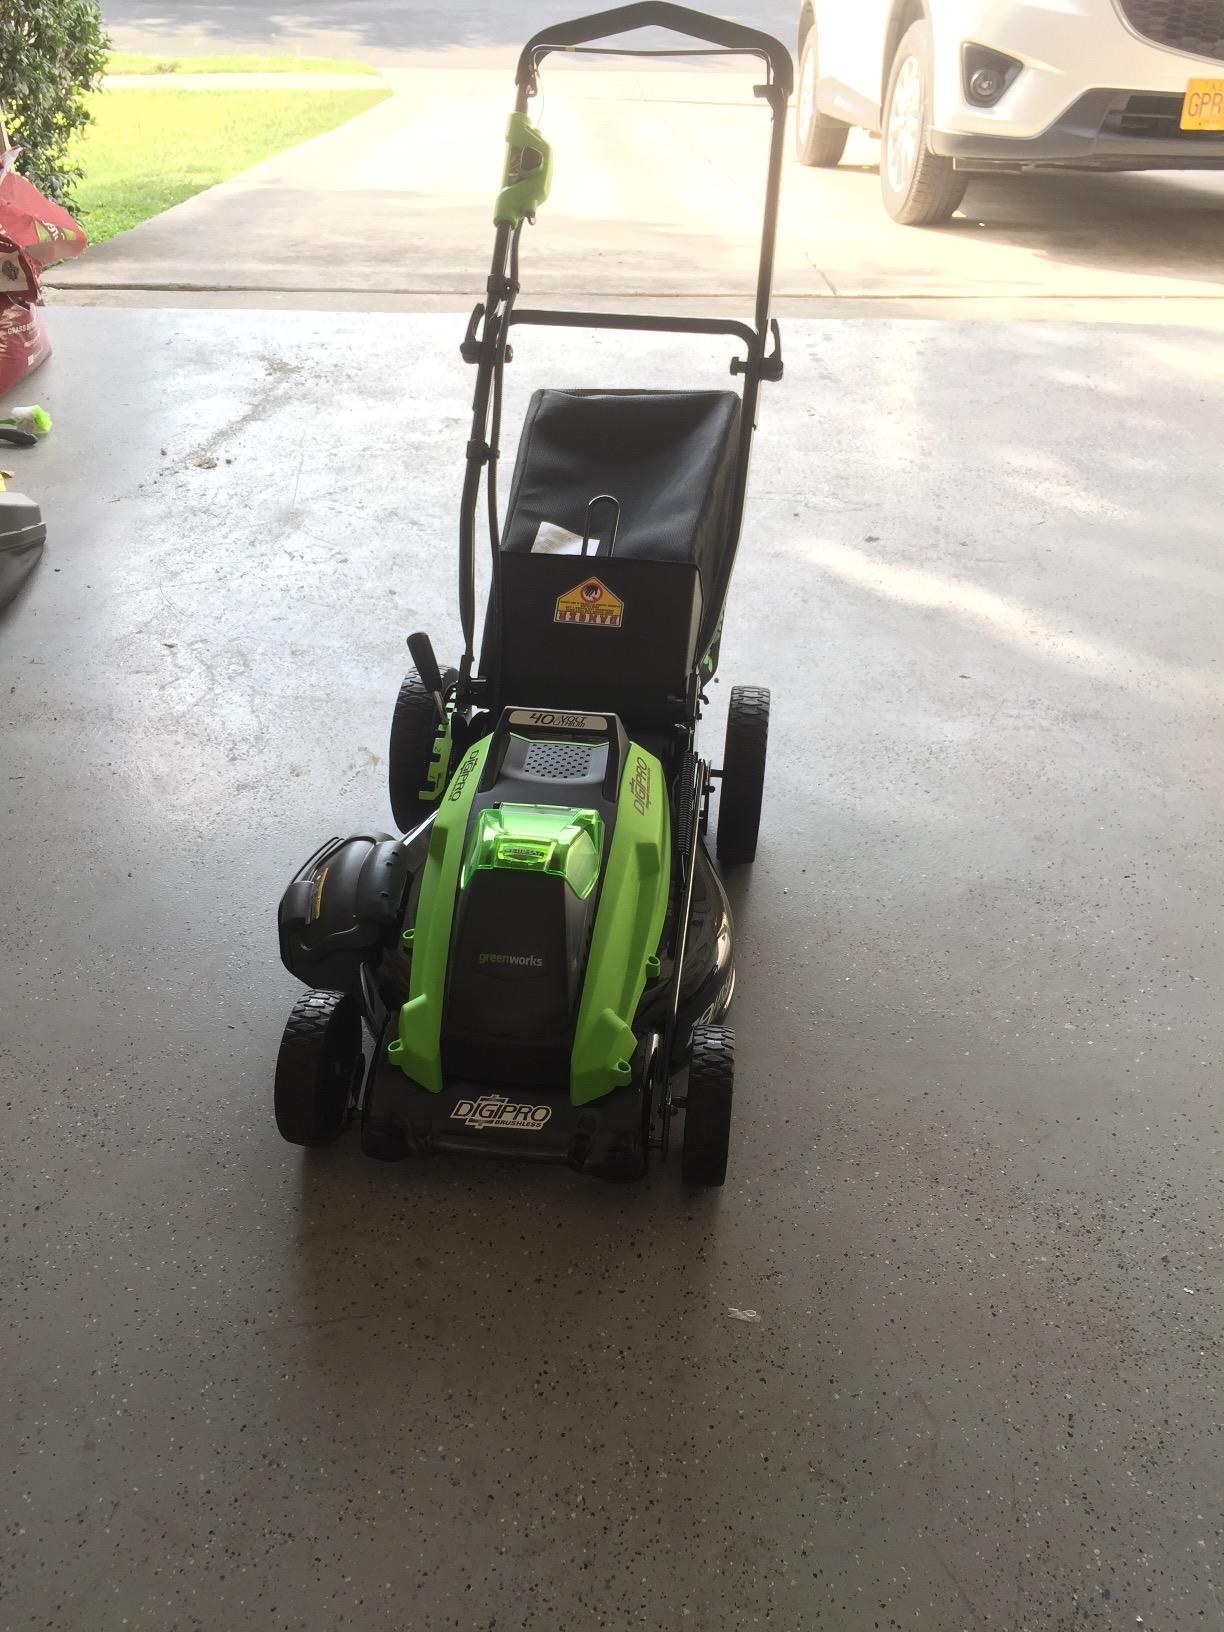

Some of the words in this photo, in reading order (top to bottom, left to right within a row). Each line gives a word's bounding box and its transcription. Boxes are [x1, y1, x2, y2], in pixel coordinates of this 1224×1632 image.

[530, 712, 555, 725] 40
[560, 715, 588, 723] VOLT
[633, 756, 648, 816] DIGIPRO
[479, 953, 543, 967] greenworks
[452, 1101, 551, 1122] DIGIPRO
[494, 1119, 542, 1128] BRUSHLESS
